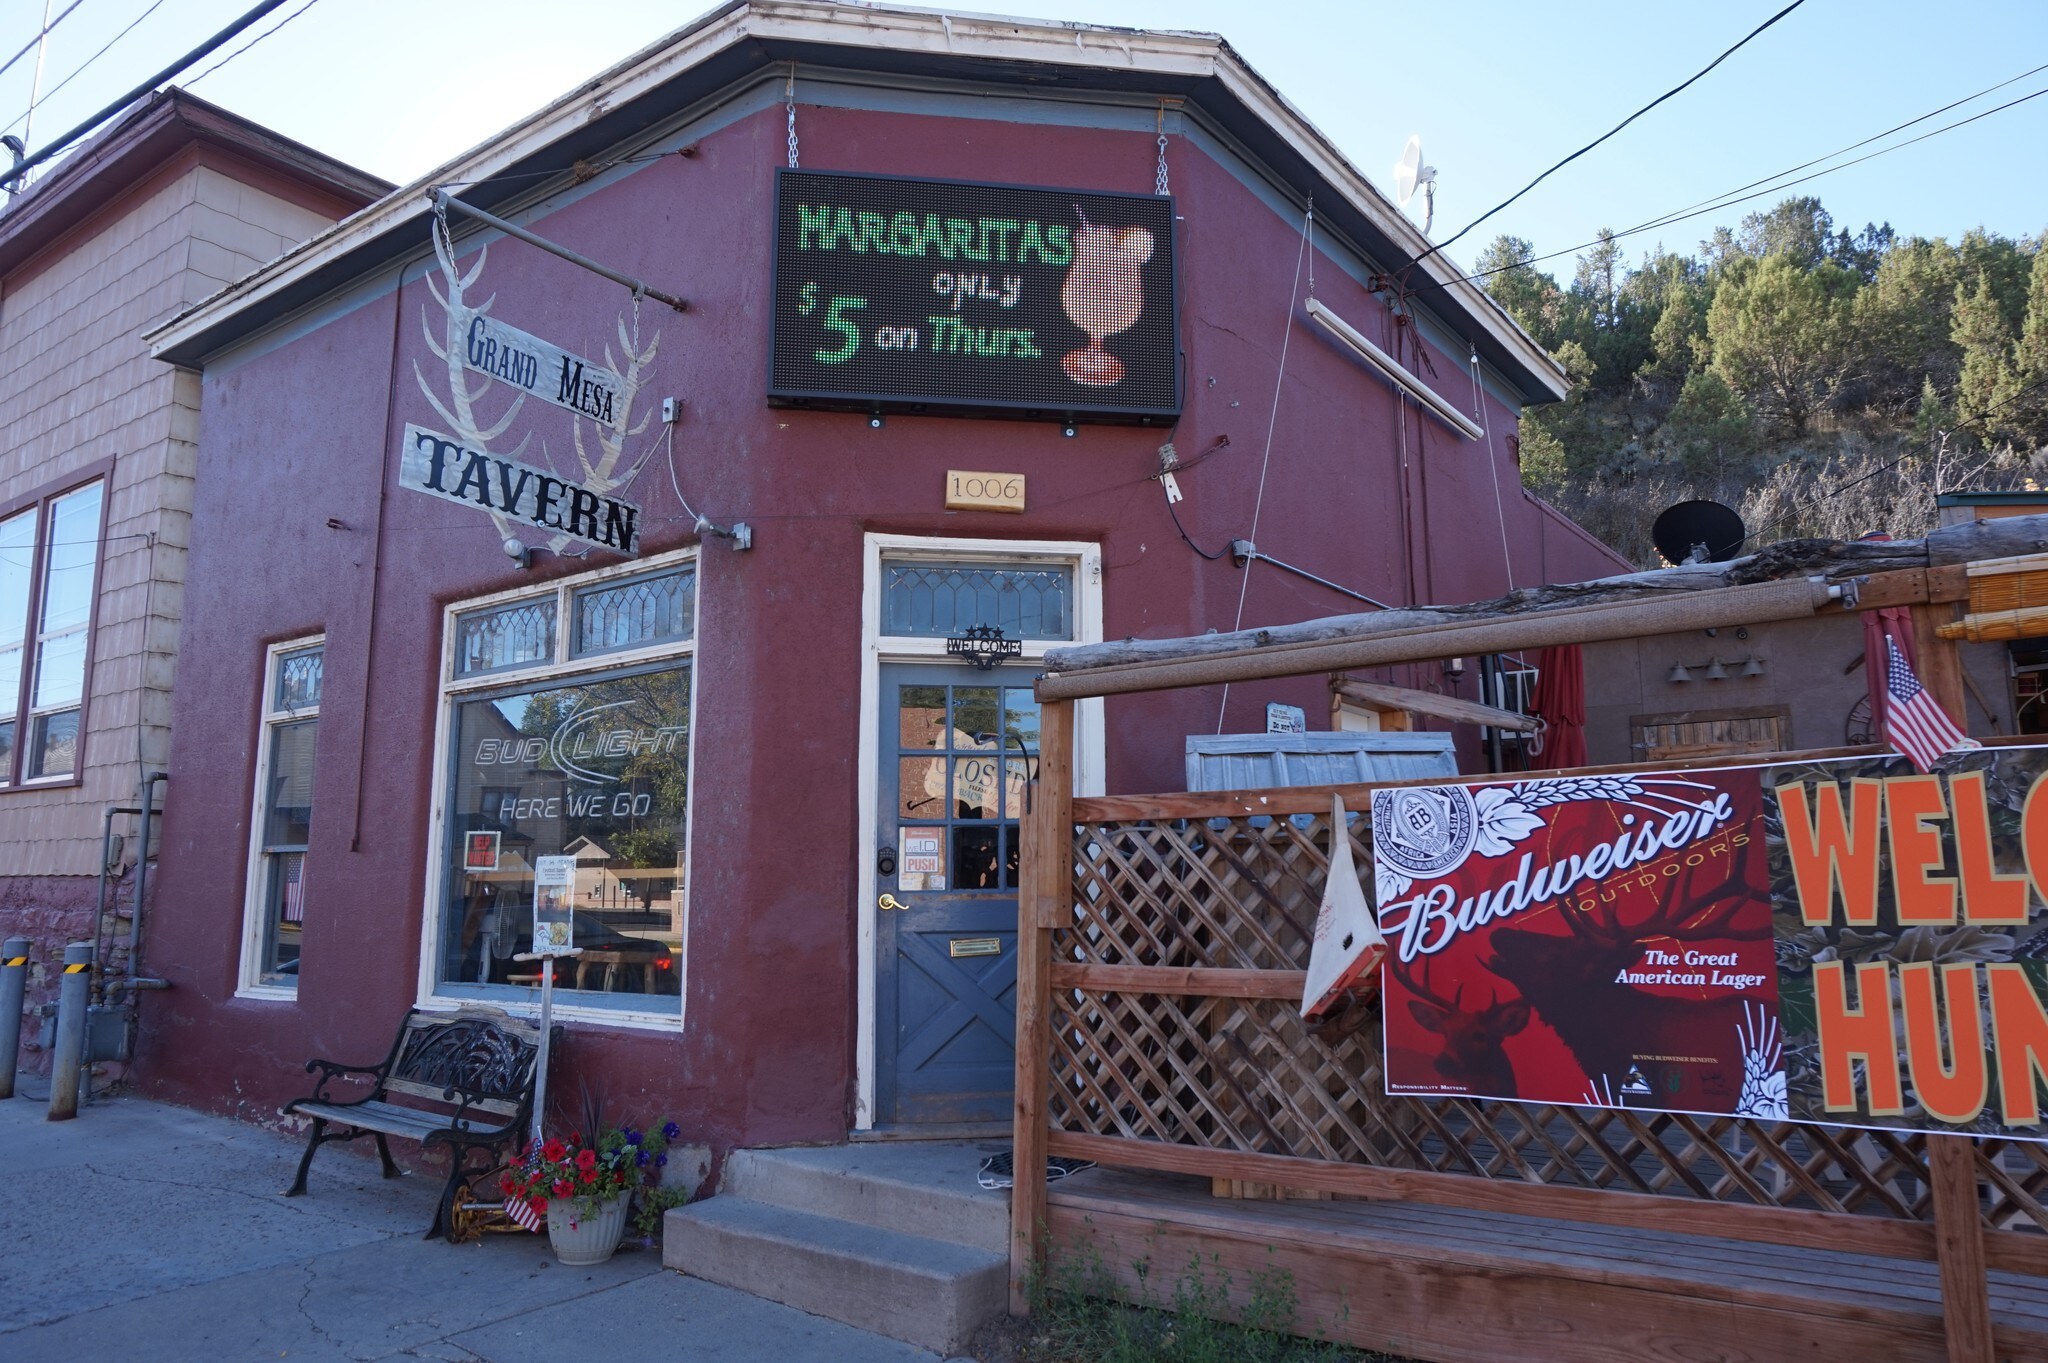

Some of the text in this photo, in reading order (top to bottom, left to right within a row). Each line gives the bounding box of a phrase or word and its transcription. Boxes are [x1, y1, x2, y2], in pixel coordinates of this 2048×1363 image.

[798, 202, 1075, 266] MARGARITAS
[467, 316, 613, 424] GRAND MESA
[415, 431, 638, 552] TAVERN
[952, 477, 1024, 499] 1006
[947, 637, 1021, 654] WELCOME
[475, 726, 688, 764] BUD LIGHT
[500, 792, 650, 819] HERE WE GO
[1450, 813, 1459, 834] ASIA
[1399, 845, 1425, 858] AFRICA
[907, 858, 936, 871] PUSH
[1578, 832, 1751, 912] OUTDOORS
[1379, 793, 1732, 963] Budweiser
[1645, 950, 1739, 967] The Great
[1614, 969, 1766, 990] American Lager
